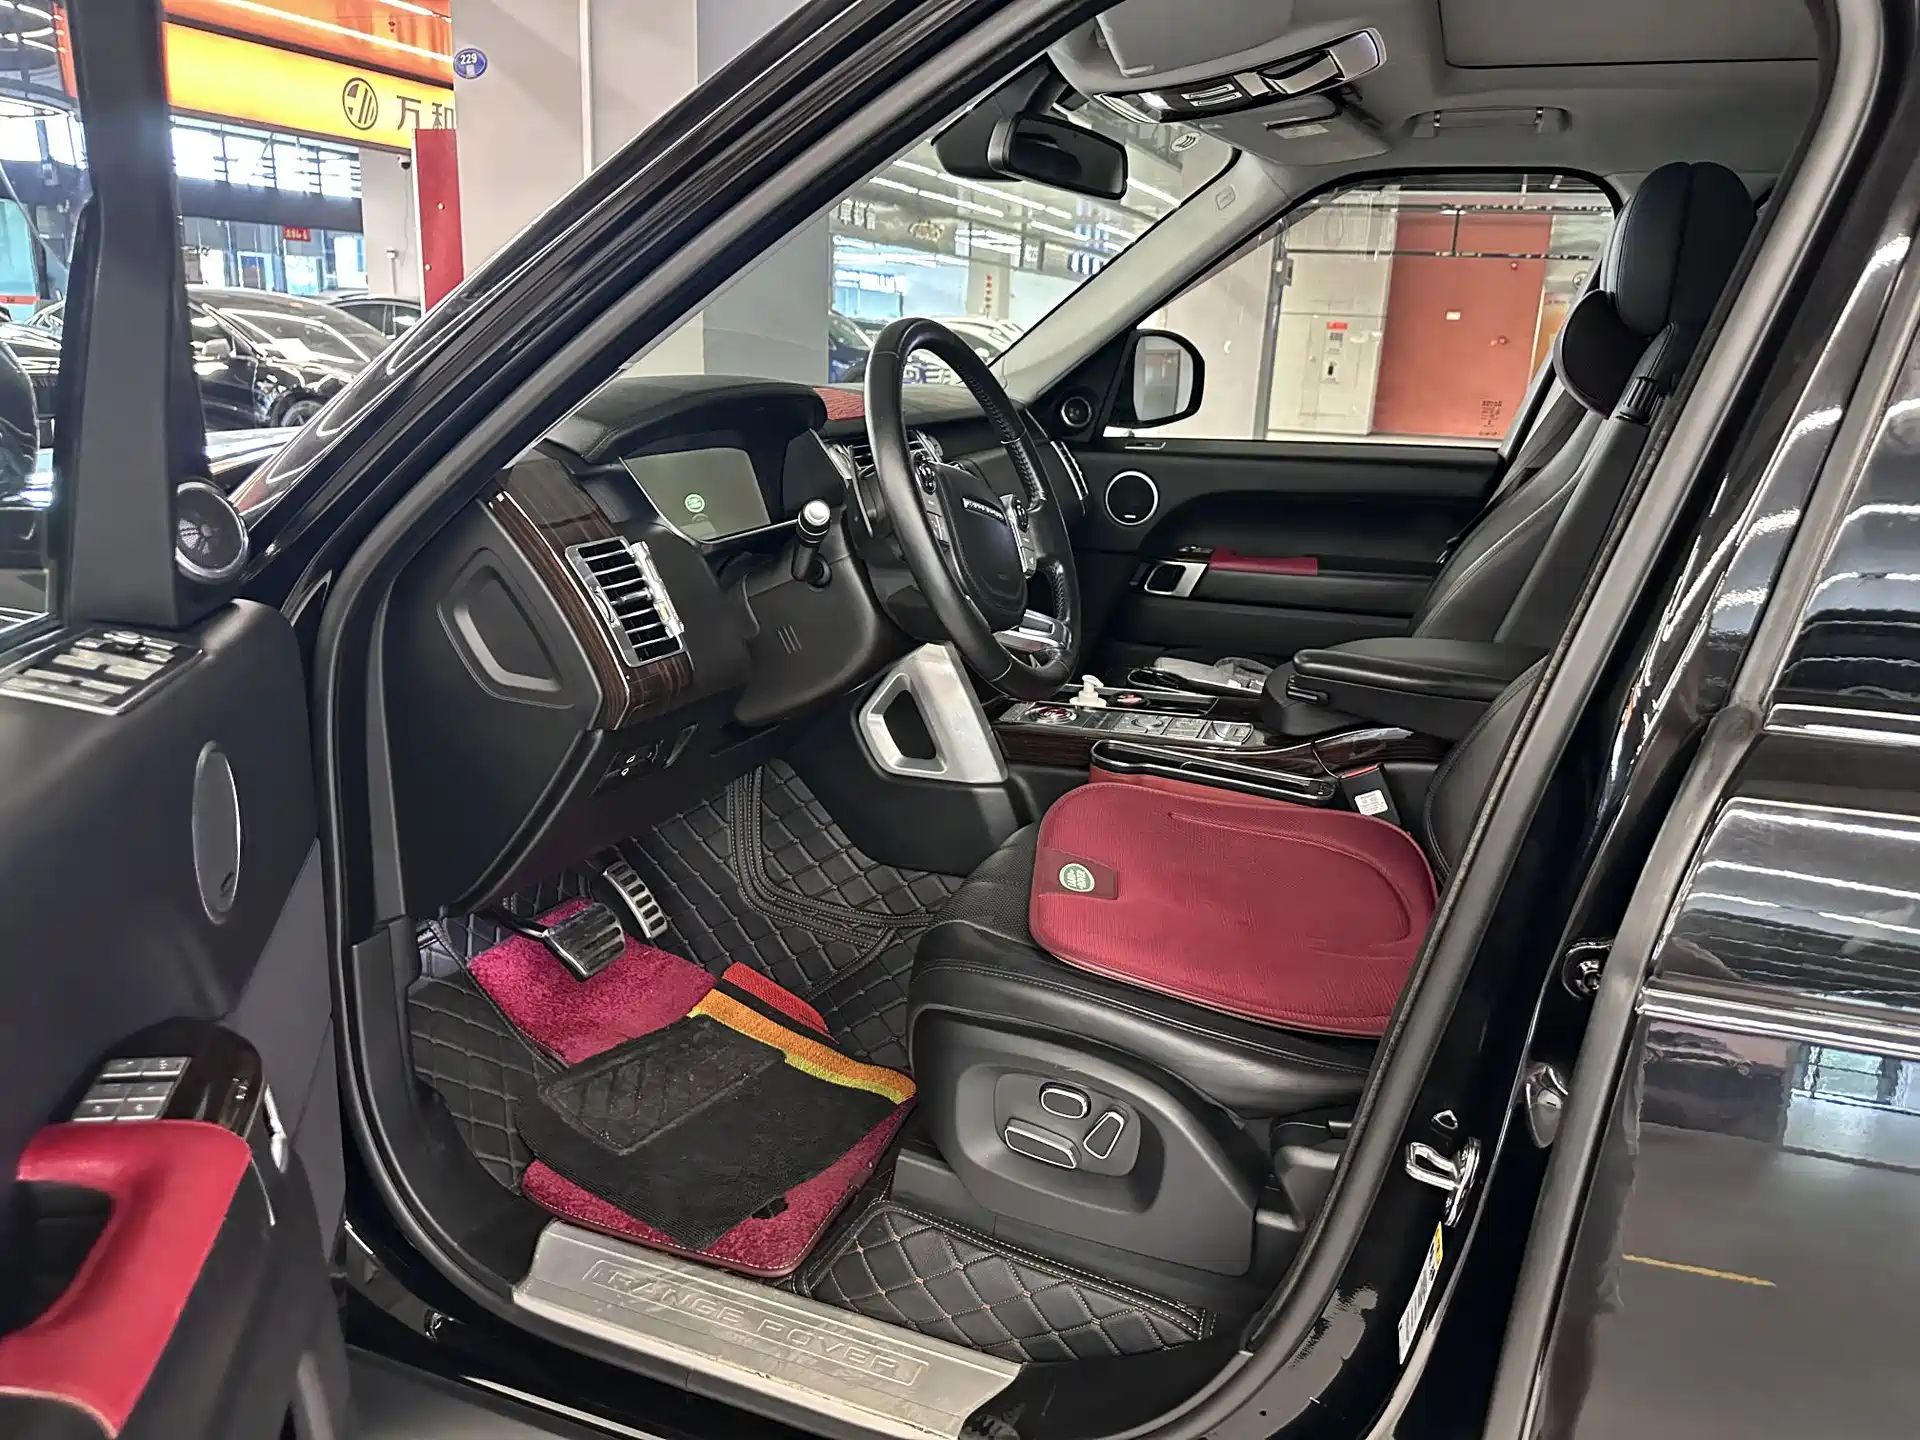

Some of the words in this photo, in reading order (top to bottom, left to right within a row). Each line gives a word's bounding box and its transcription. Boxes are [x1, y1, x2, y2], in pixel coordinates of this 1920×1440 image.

[460, 53, 477, 65] 229
[607, 1270, 745, 1324] RANGE
[756, 1317, 900, 1373] ROVER
